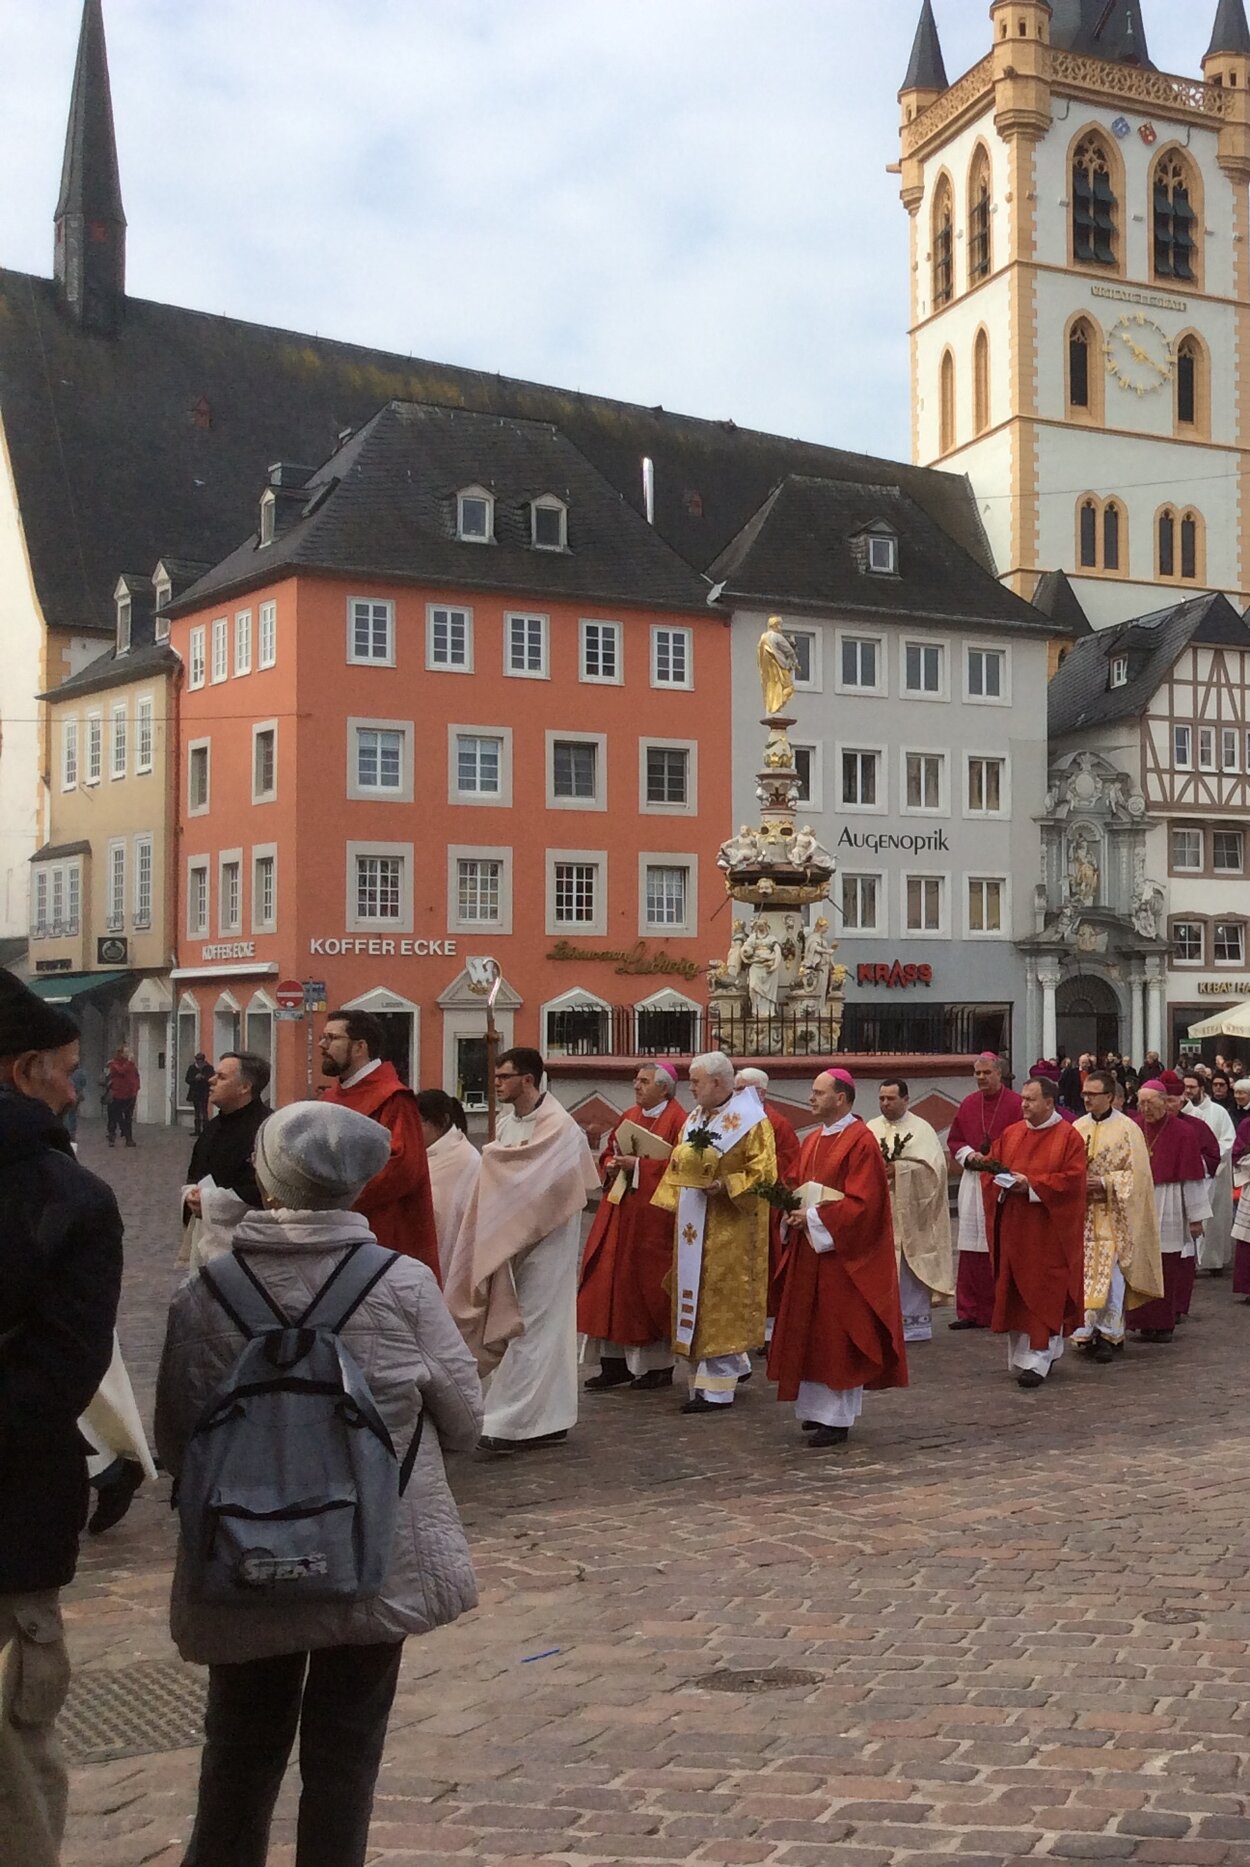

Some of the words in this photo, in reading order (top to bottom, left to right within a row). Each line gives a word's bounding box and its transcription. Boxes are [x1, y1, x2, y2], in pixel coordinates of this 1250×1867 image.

[310, 938, 395, 954] KOFFER
[400, 940, 457, 955] ECKE
[857, 959, 932, 987] KRASS
